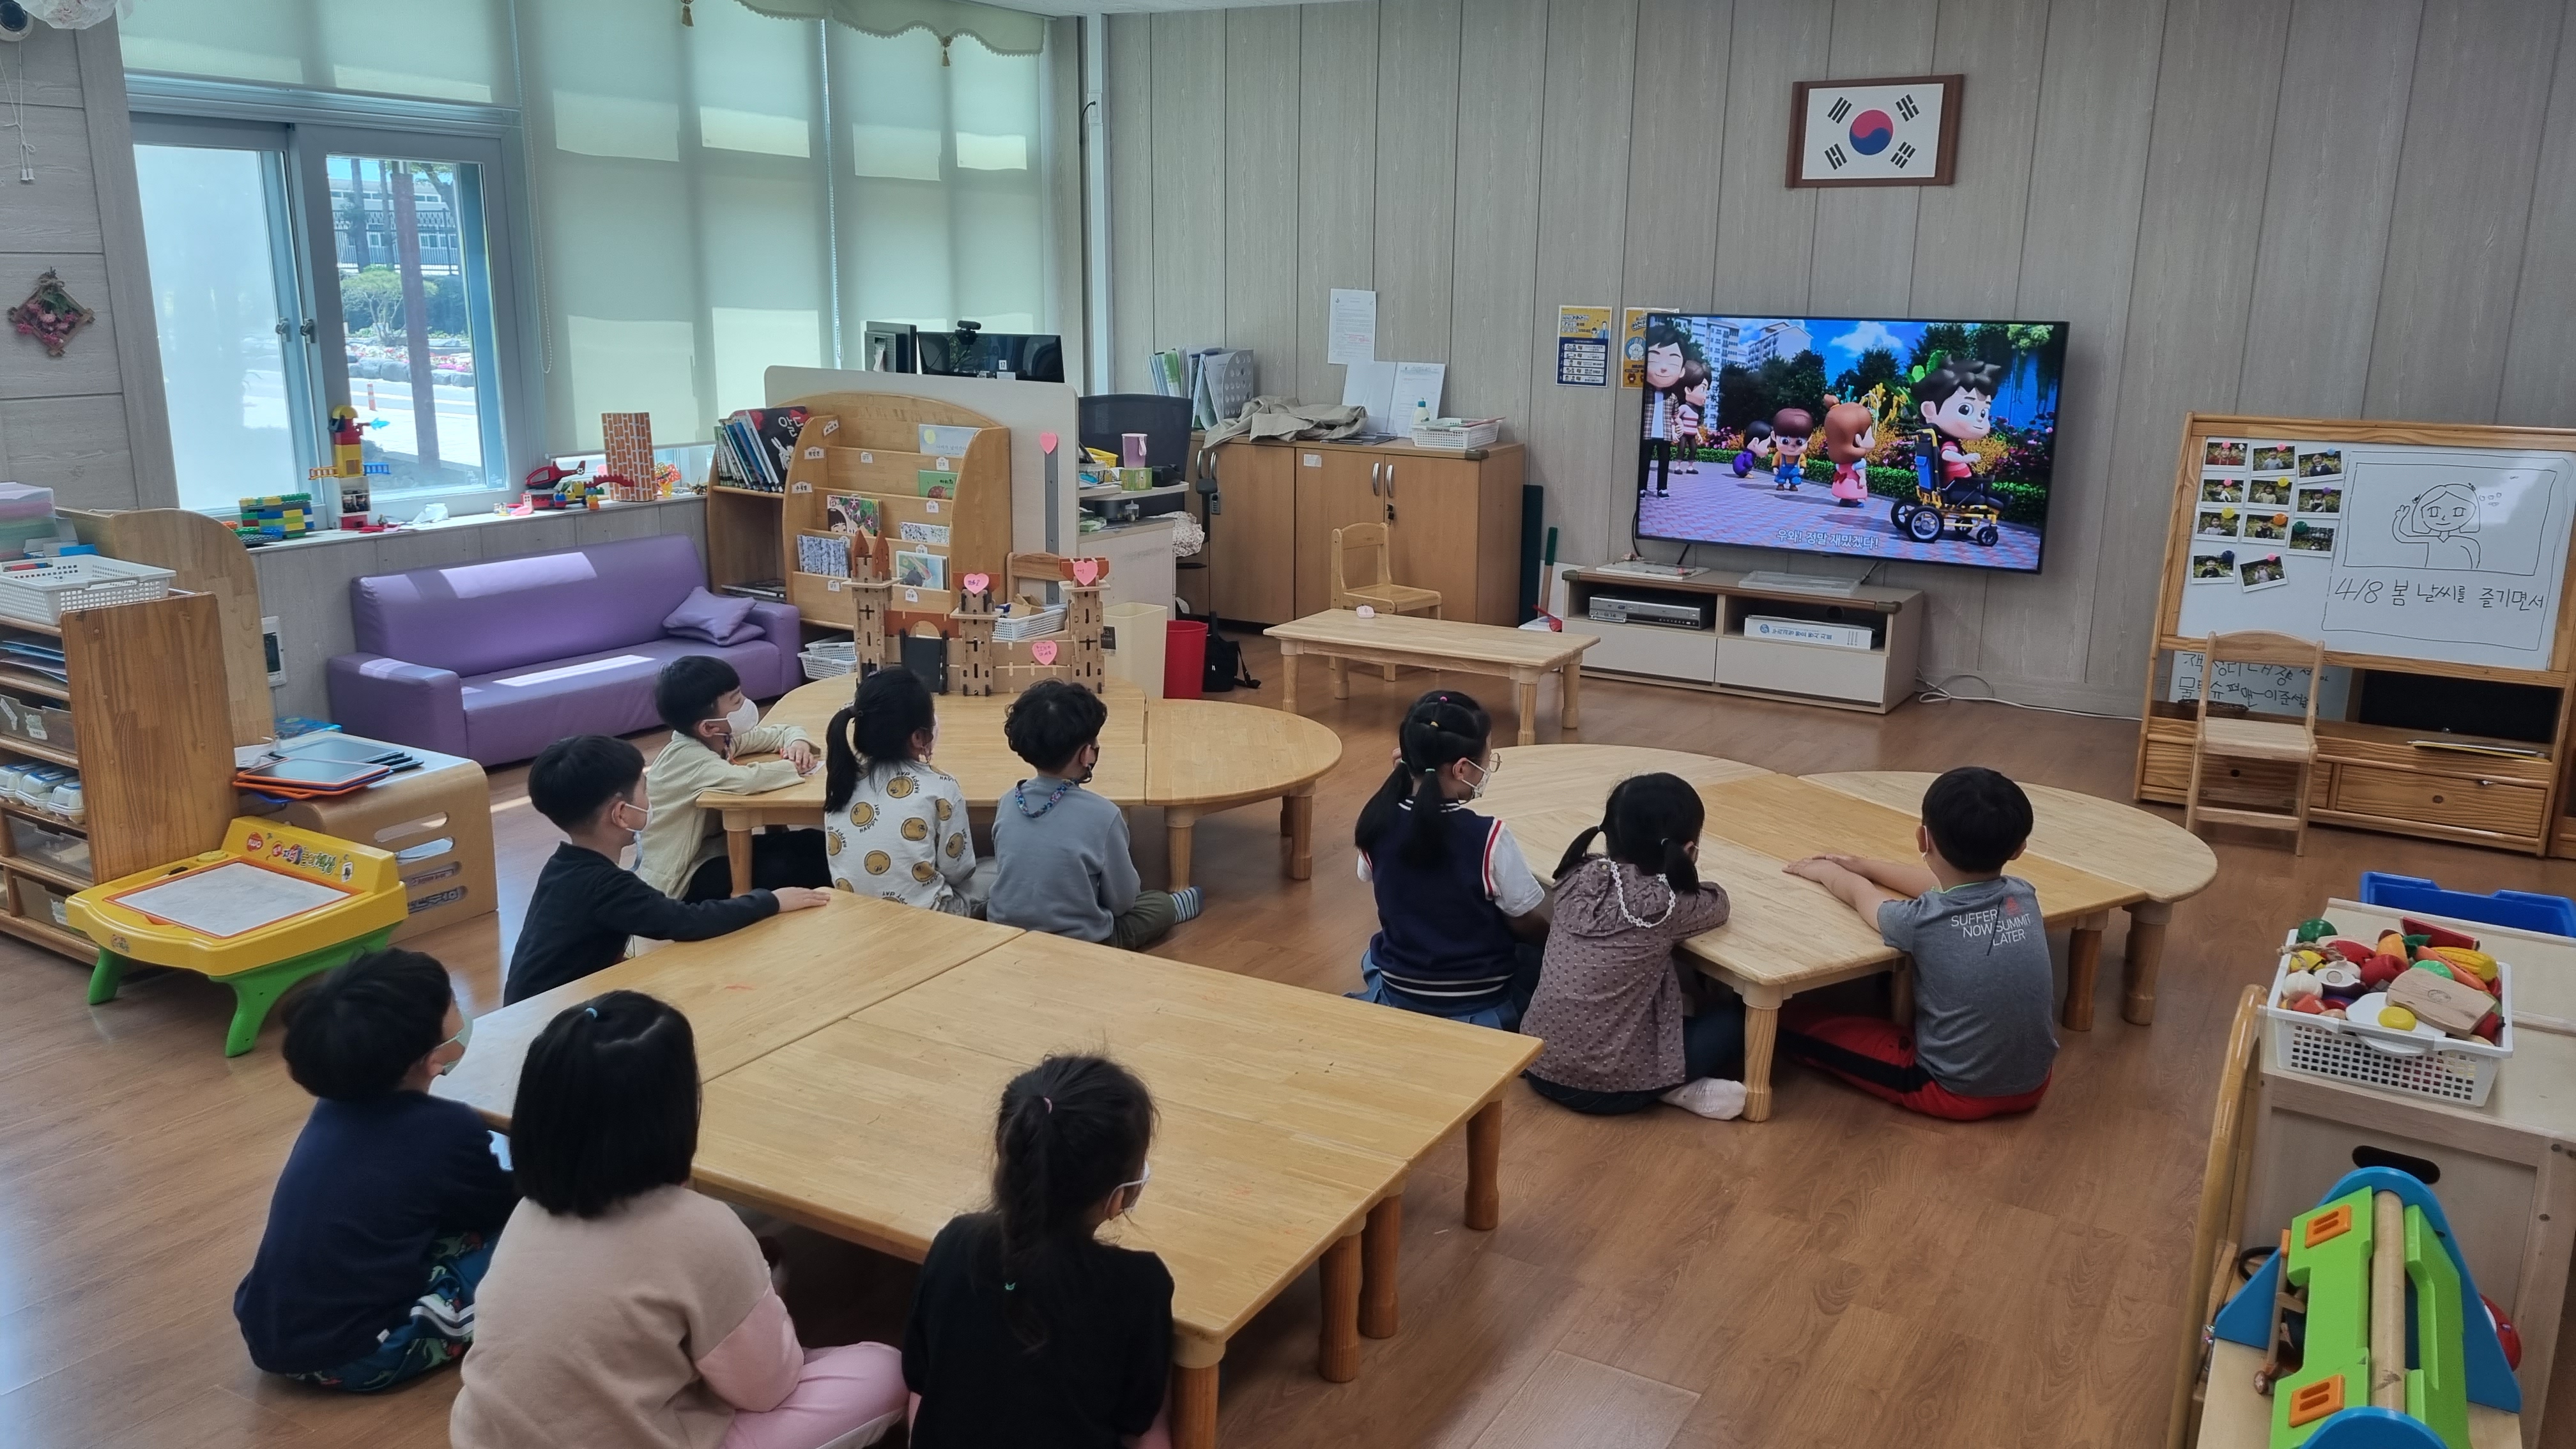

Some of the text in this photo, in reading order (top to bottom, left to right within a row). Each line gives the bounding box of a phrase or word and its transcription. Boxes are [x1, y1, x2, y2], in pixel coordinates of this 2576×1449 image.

[1777, 529, 1879, 549] 우와! 정말 재밌겠다!
[2334, 578, 2545, 611] 4/8 봄 날씨를 즐기면서
[859, 817, 878, 834] HAPPY
[1951, 908, 1998, 927] SUFFER
[1995, 914, 2031, 933] SUMMIT
[1963, 922, 1993, 939] NOW
[1993, 928, 2026, 947] LATER
